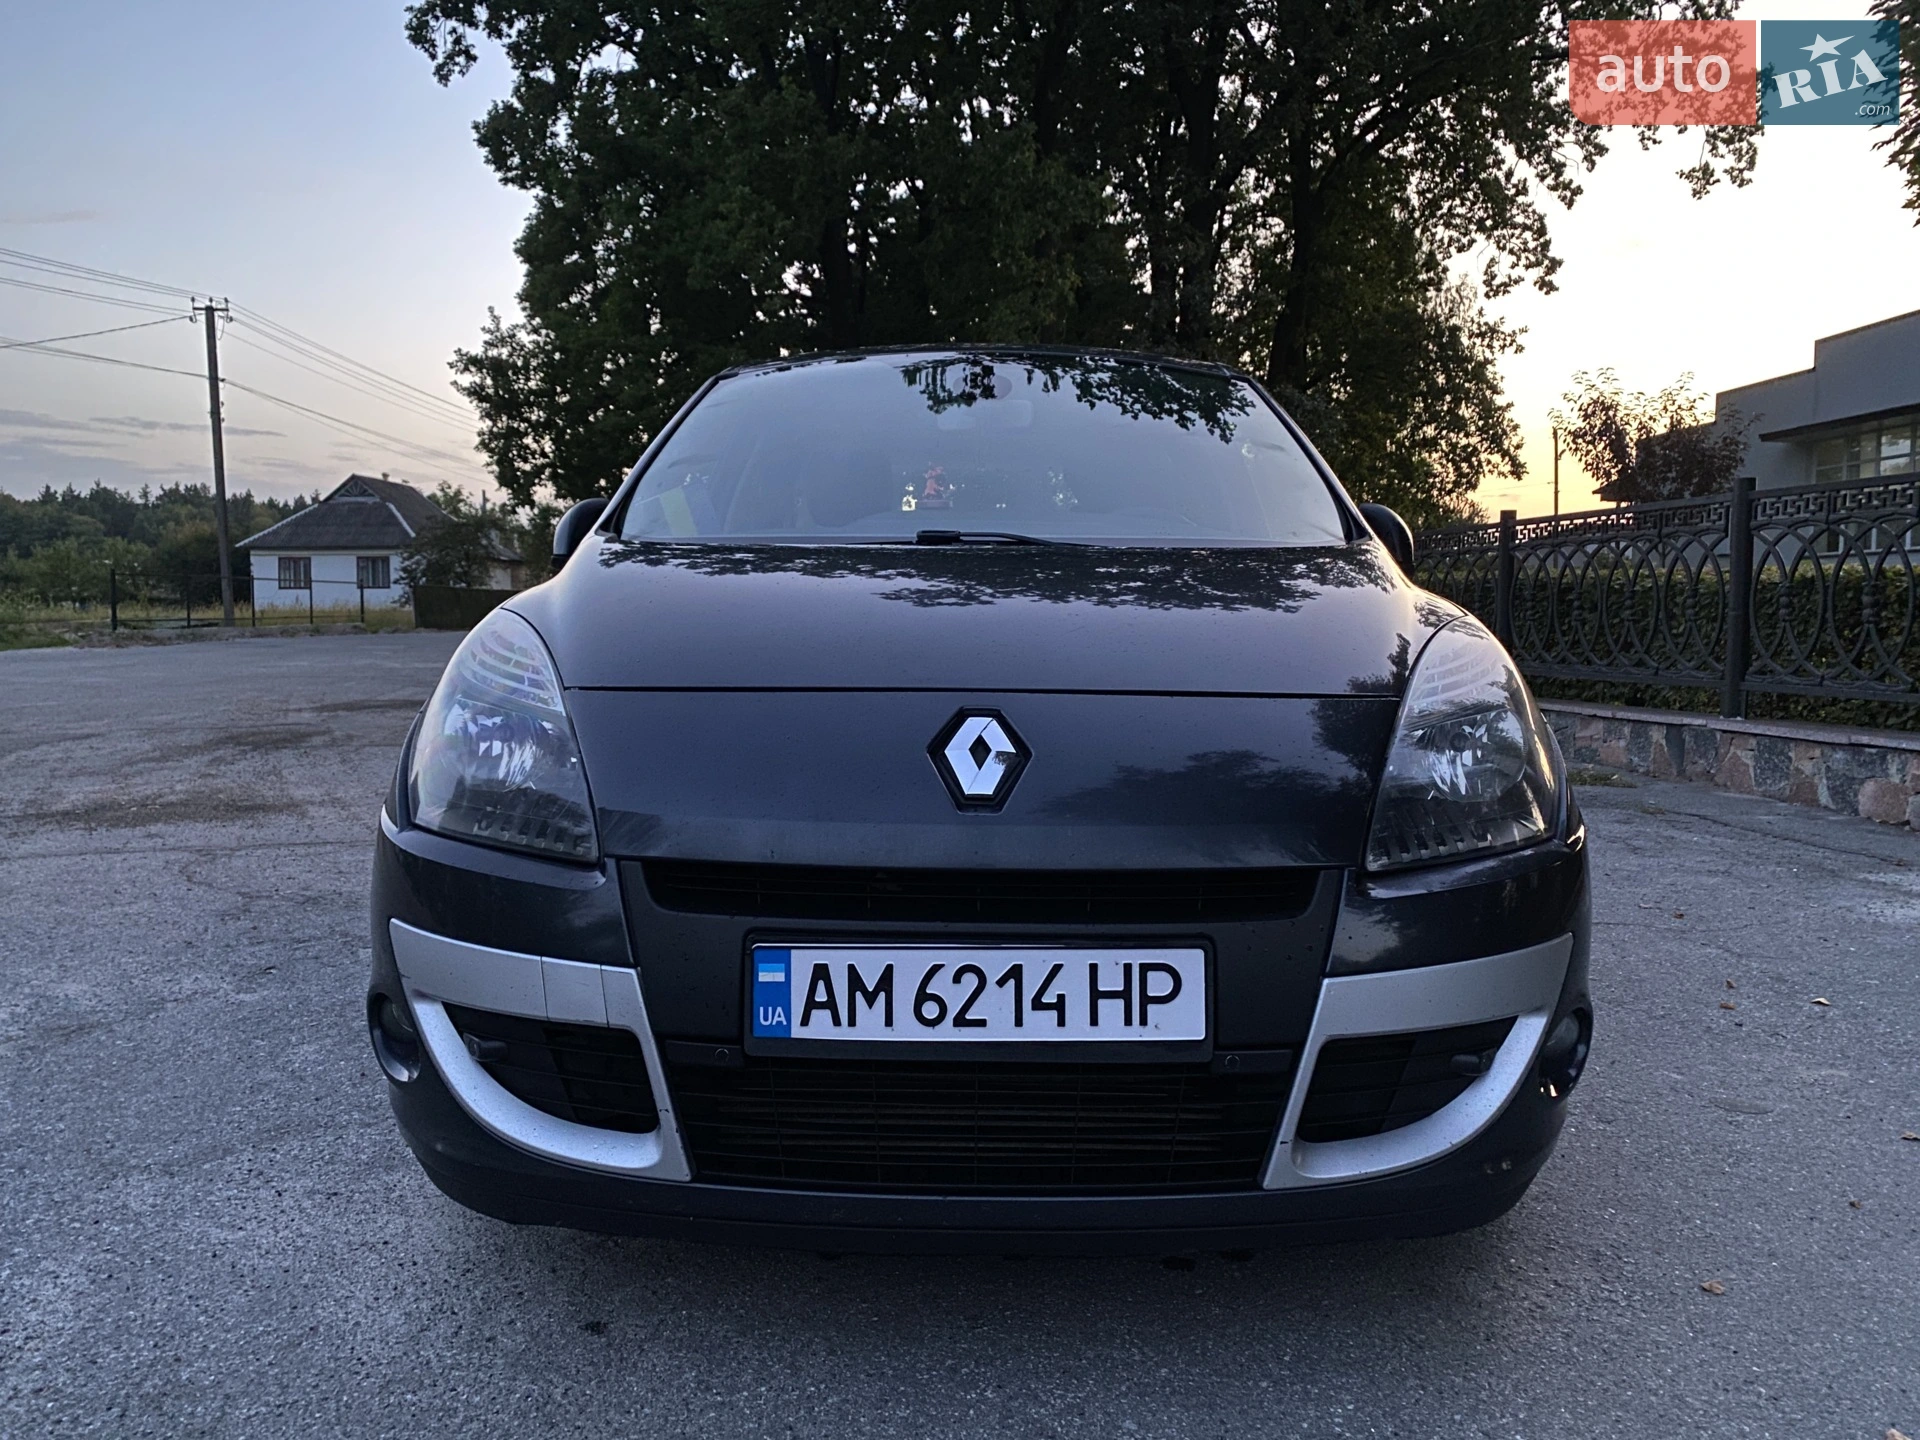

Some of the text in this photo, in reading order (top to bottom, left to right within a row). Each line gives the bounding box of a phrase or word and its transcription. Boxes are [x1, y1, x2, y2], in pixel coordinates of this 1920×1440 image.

[800, 962, 1183, 1027] AM 6214 HP
[759, 1006, 787, 1026] UA
